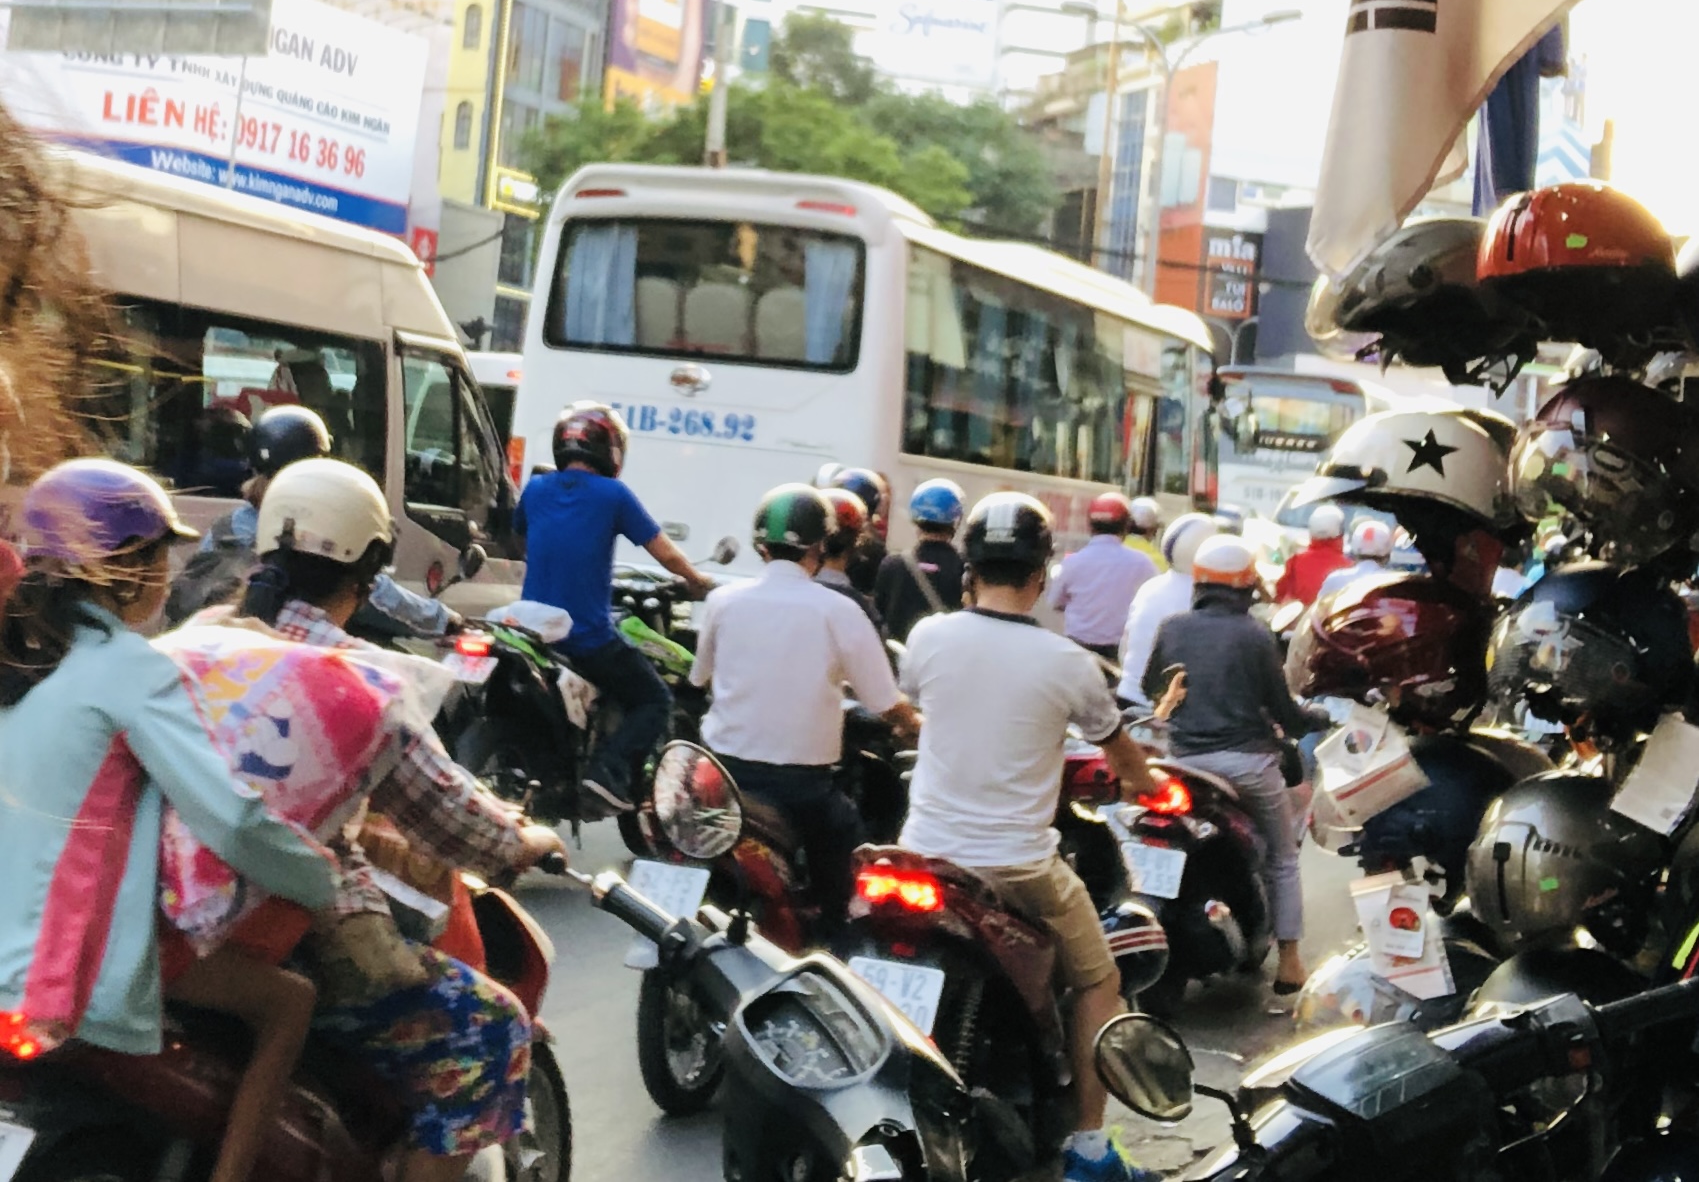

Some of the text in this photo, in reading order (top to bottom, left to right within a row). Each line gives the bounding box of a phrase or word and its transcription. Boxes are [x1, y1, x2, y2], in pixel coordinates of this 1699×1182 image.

[269, 24, 359, 78] GAN ADV
[102, 86, 367, 180] LIÊN HỆ: 0917 16 36 96
[340, 108, 362, 127] KIM
[151, 149, 216, 181] Website:
[1208, 234, 1256, 262] mia
[611, 401, 756, 443] 1B-268.92
